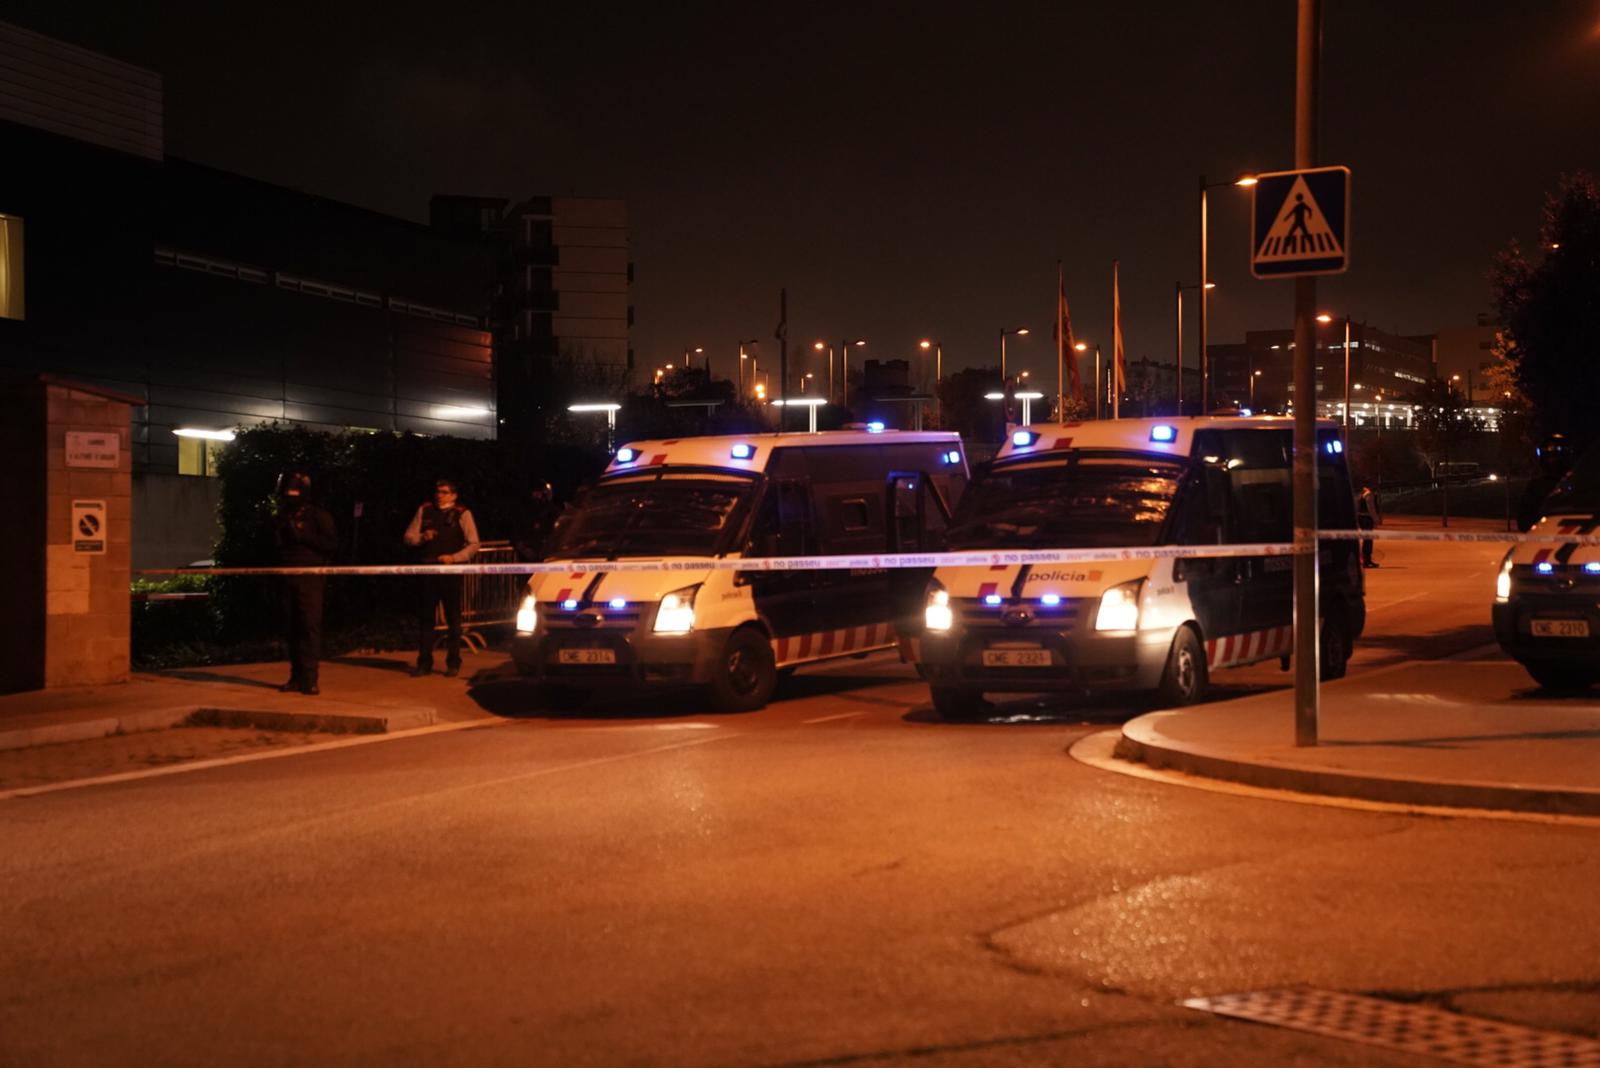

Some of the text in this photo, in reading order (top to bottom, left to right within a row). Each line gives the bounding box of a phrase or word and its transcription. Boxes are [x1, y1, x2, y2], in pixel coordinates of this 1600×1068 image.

[1004, 554, 1019, 562] no
[1021, 553, 1060, 563] passeu
[1135, 549, 1197, 559] no passeu
[685, 562, 715, 571] passeu
[787, 560, 821, 570] passeu
[884, 557, 897, 565] no
[899, 556, 936, 567] passeu
[1027, 570, 1086, 583] policia
[986, 651, 1045, 665] CME 2321
